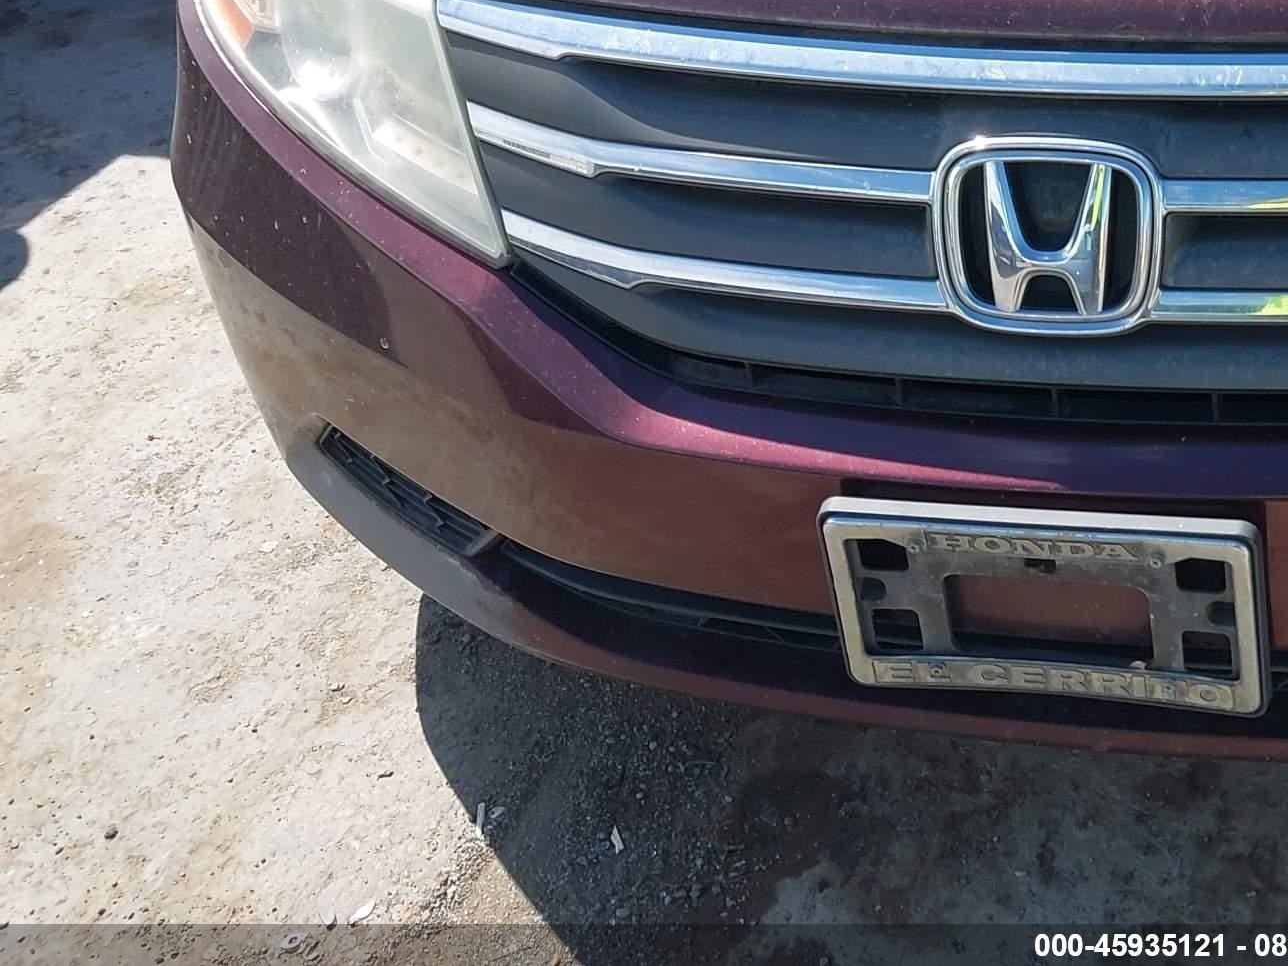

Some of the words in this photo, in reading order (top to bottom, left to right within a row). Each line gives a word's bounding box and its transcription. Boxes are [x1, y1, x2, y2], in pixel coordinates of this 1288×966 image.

[926, 532, 1139, 562] HONDA
[873, 661, 952, 683] EL
[966, 663, 1234, 709] CERRITO
